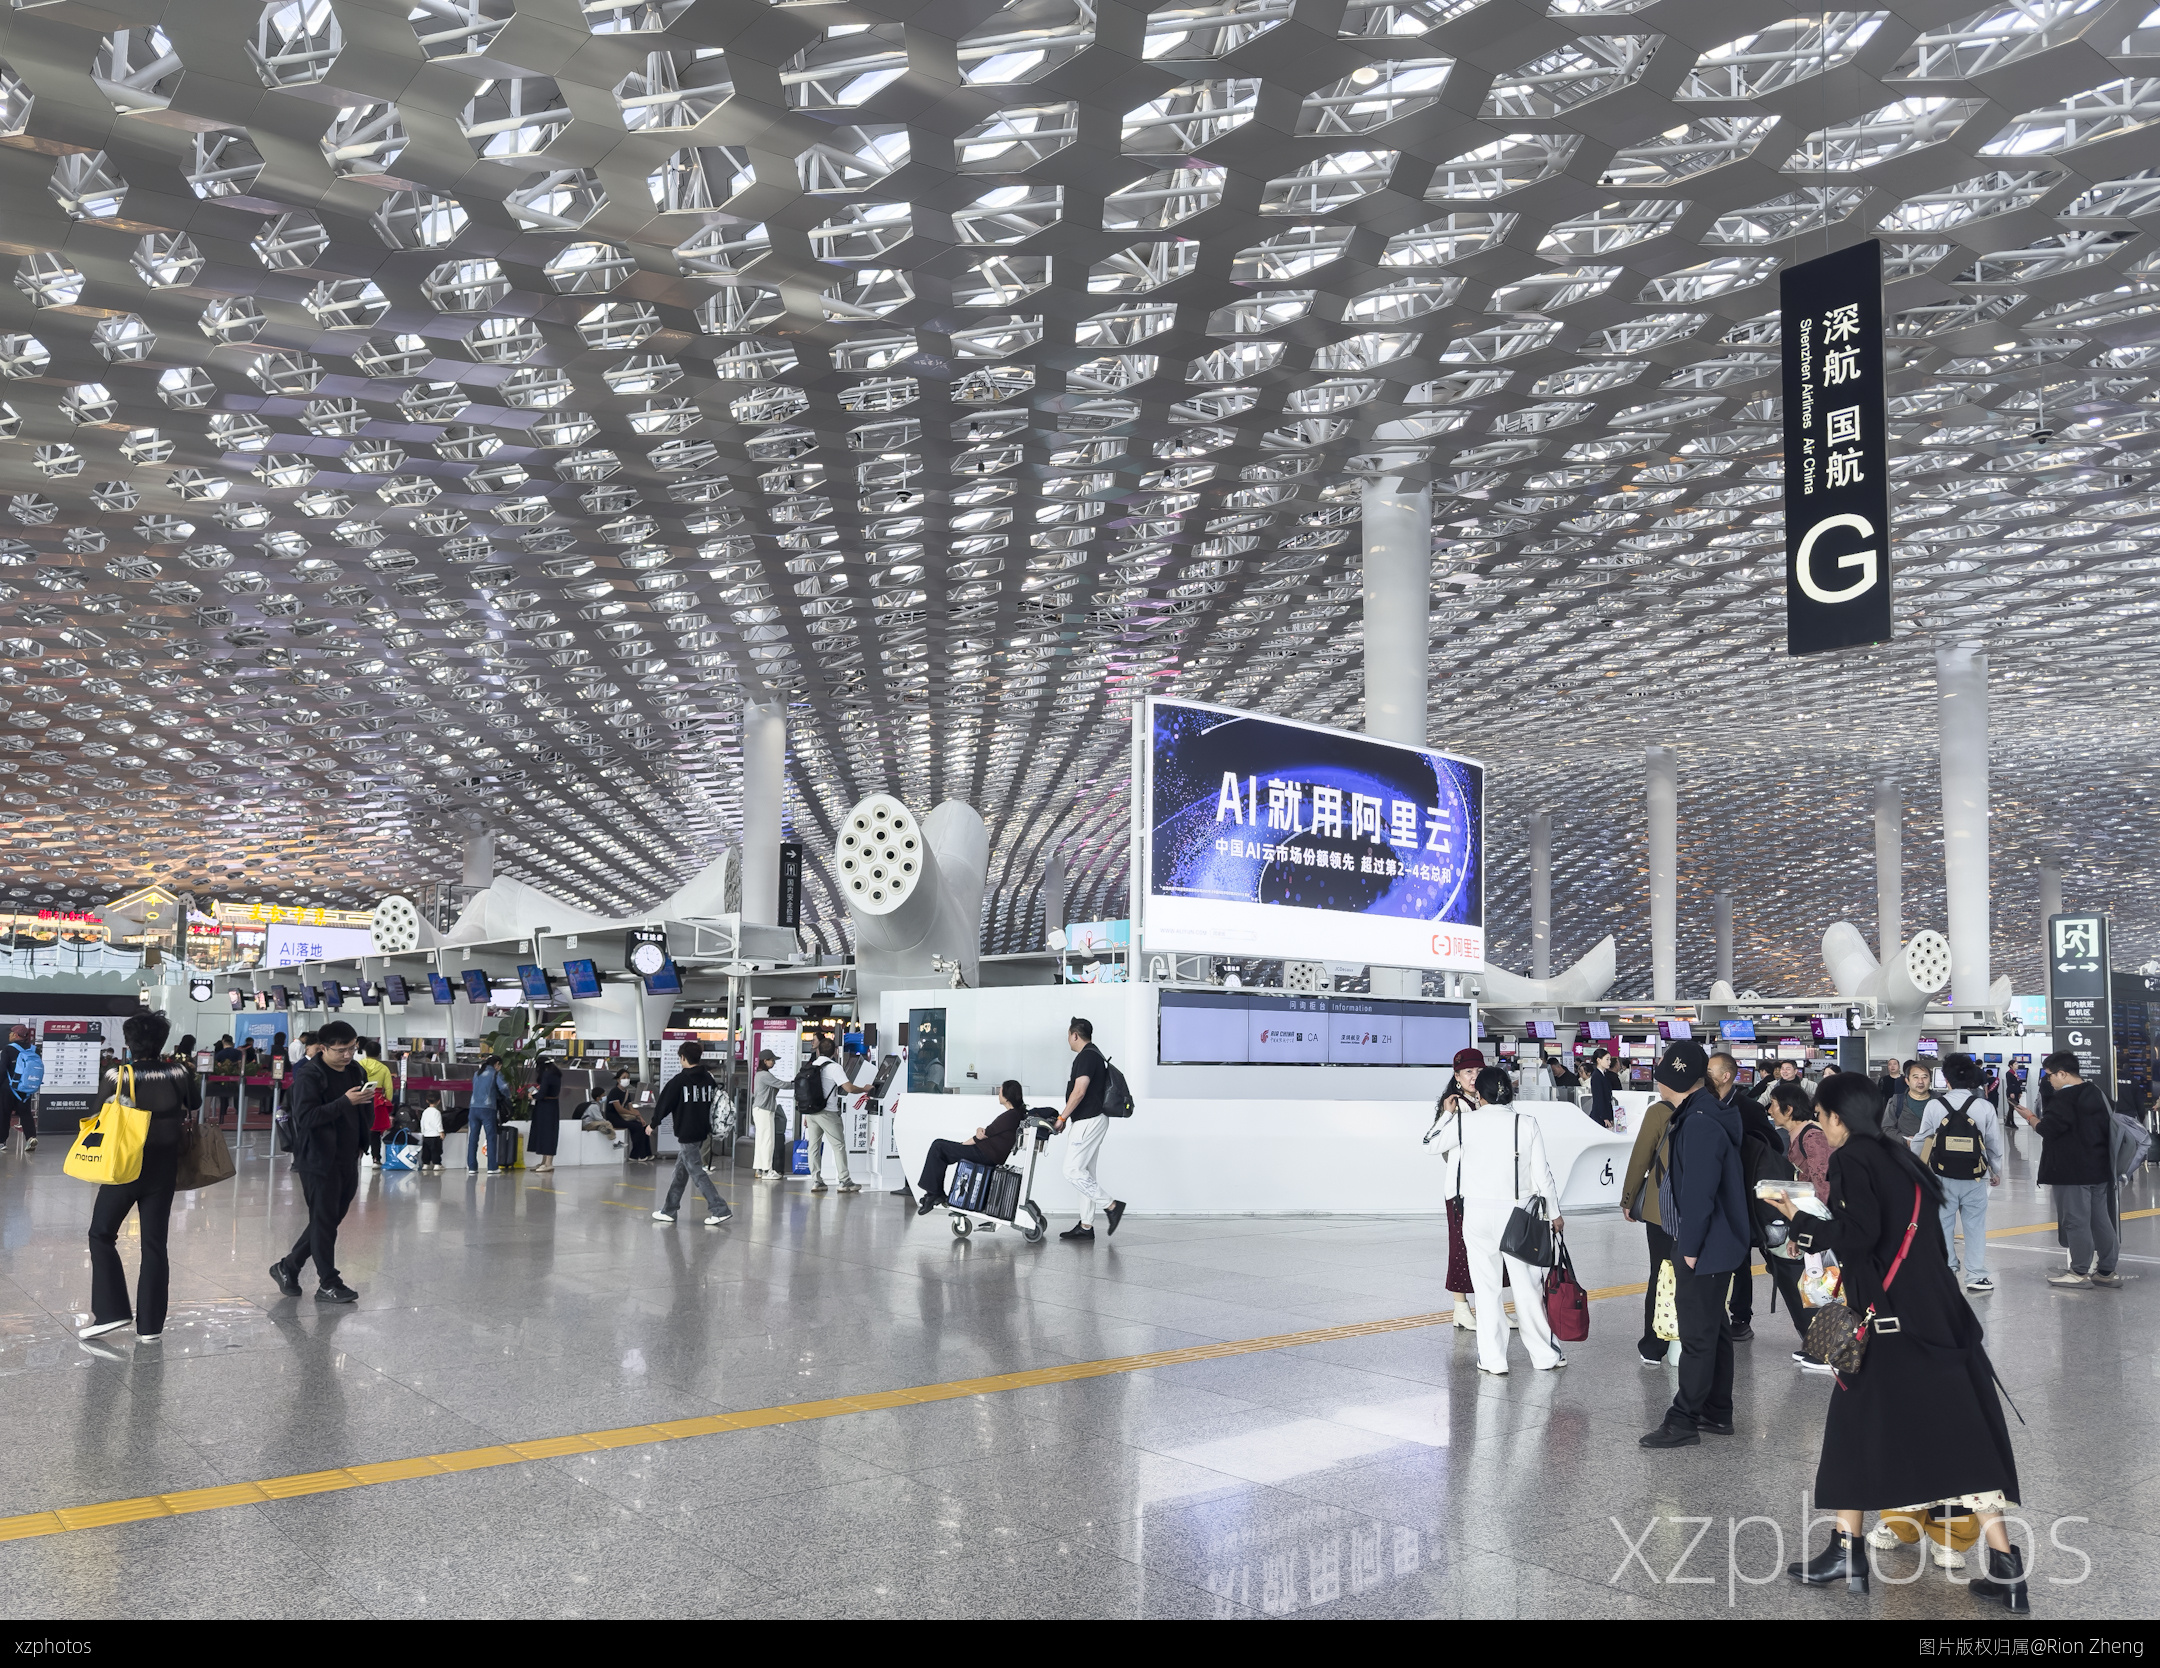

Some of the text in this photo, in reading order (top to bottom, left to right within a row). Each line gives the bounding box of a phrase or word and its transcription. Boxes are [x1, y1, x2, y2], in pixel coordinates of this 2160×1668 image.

[1822, 302, 1864, 489] 深航 国航
[1800, 318, 1815, 495] Shenzhen Airlines Air China
[1796, 513, 1878, 603] G
[1216, 771, 1451, 854] AI就用阿里云
[1215, 837, 1451, 884] 中国AI云市场份额领先 超过第2-4名总和
[280, 942, 322, 957] AI落地
[567, 937, 577, 948] G14
[1453, 937, 1479, 959] 阿里云
[1289, 1001, 1373, 1012] 问询柜台 Information
[2064, 1001, 2095, 1009] 国内航班
[2068, 1009, 2091, 1017] 值机区
[1308, 1033, 1319, 1041] CA
[1382, 1035, 1392, 1043] ZH
[2068, 1031, 2083, 1046] G
